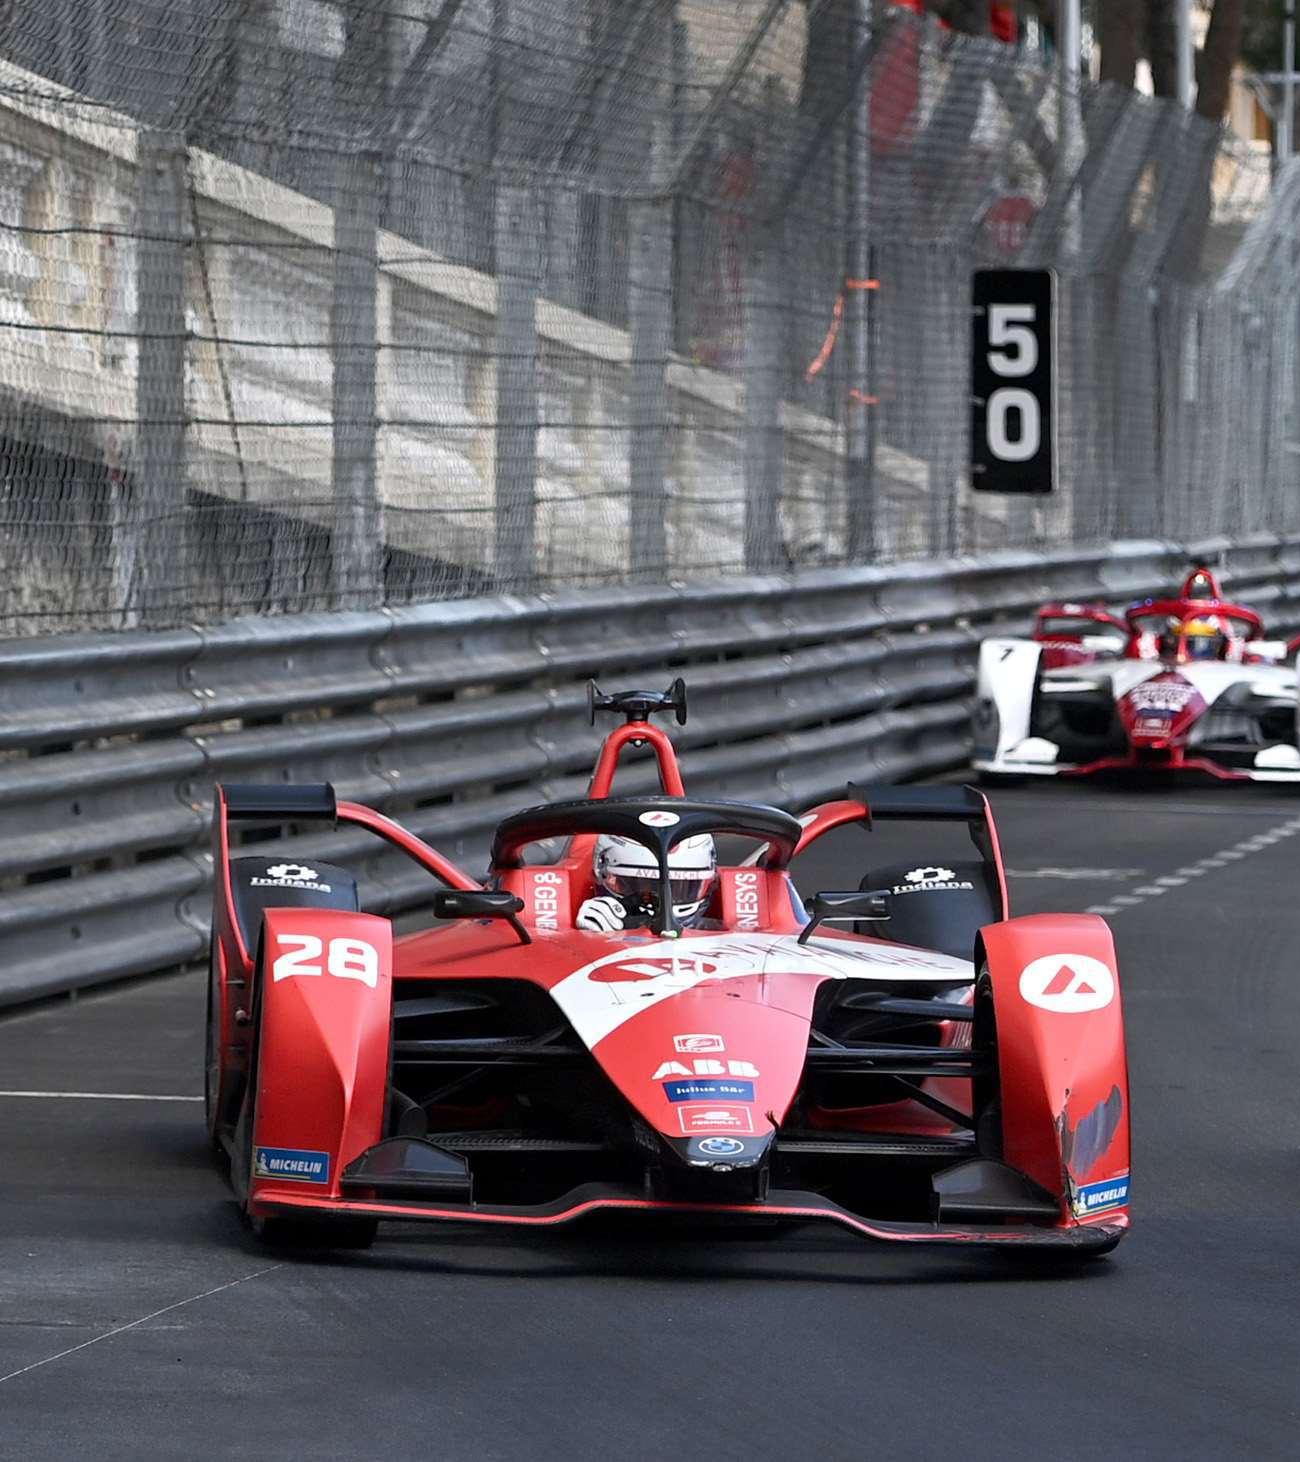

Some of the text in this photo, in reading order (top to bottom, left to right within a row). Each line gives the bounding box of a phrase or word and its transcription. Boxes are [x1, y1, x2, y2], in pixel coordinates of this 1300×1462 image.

[986, 304, 1040, 462] 50
[635, 868, 704, 881] AVAANCHE
[273, 934, 378, 988] 28
[651, 1059, 761, 1080] ABB
[269, 1158, 322, 1173] MICHELIN
[1087, 1186, 1128, 1206] MICHELIN
